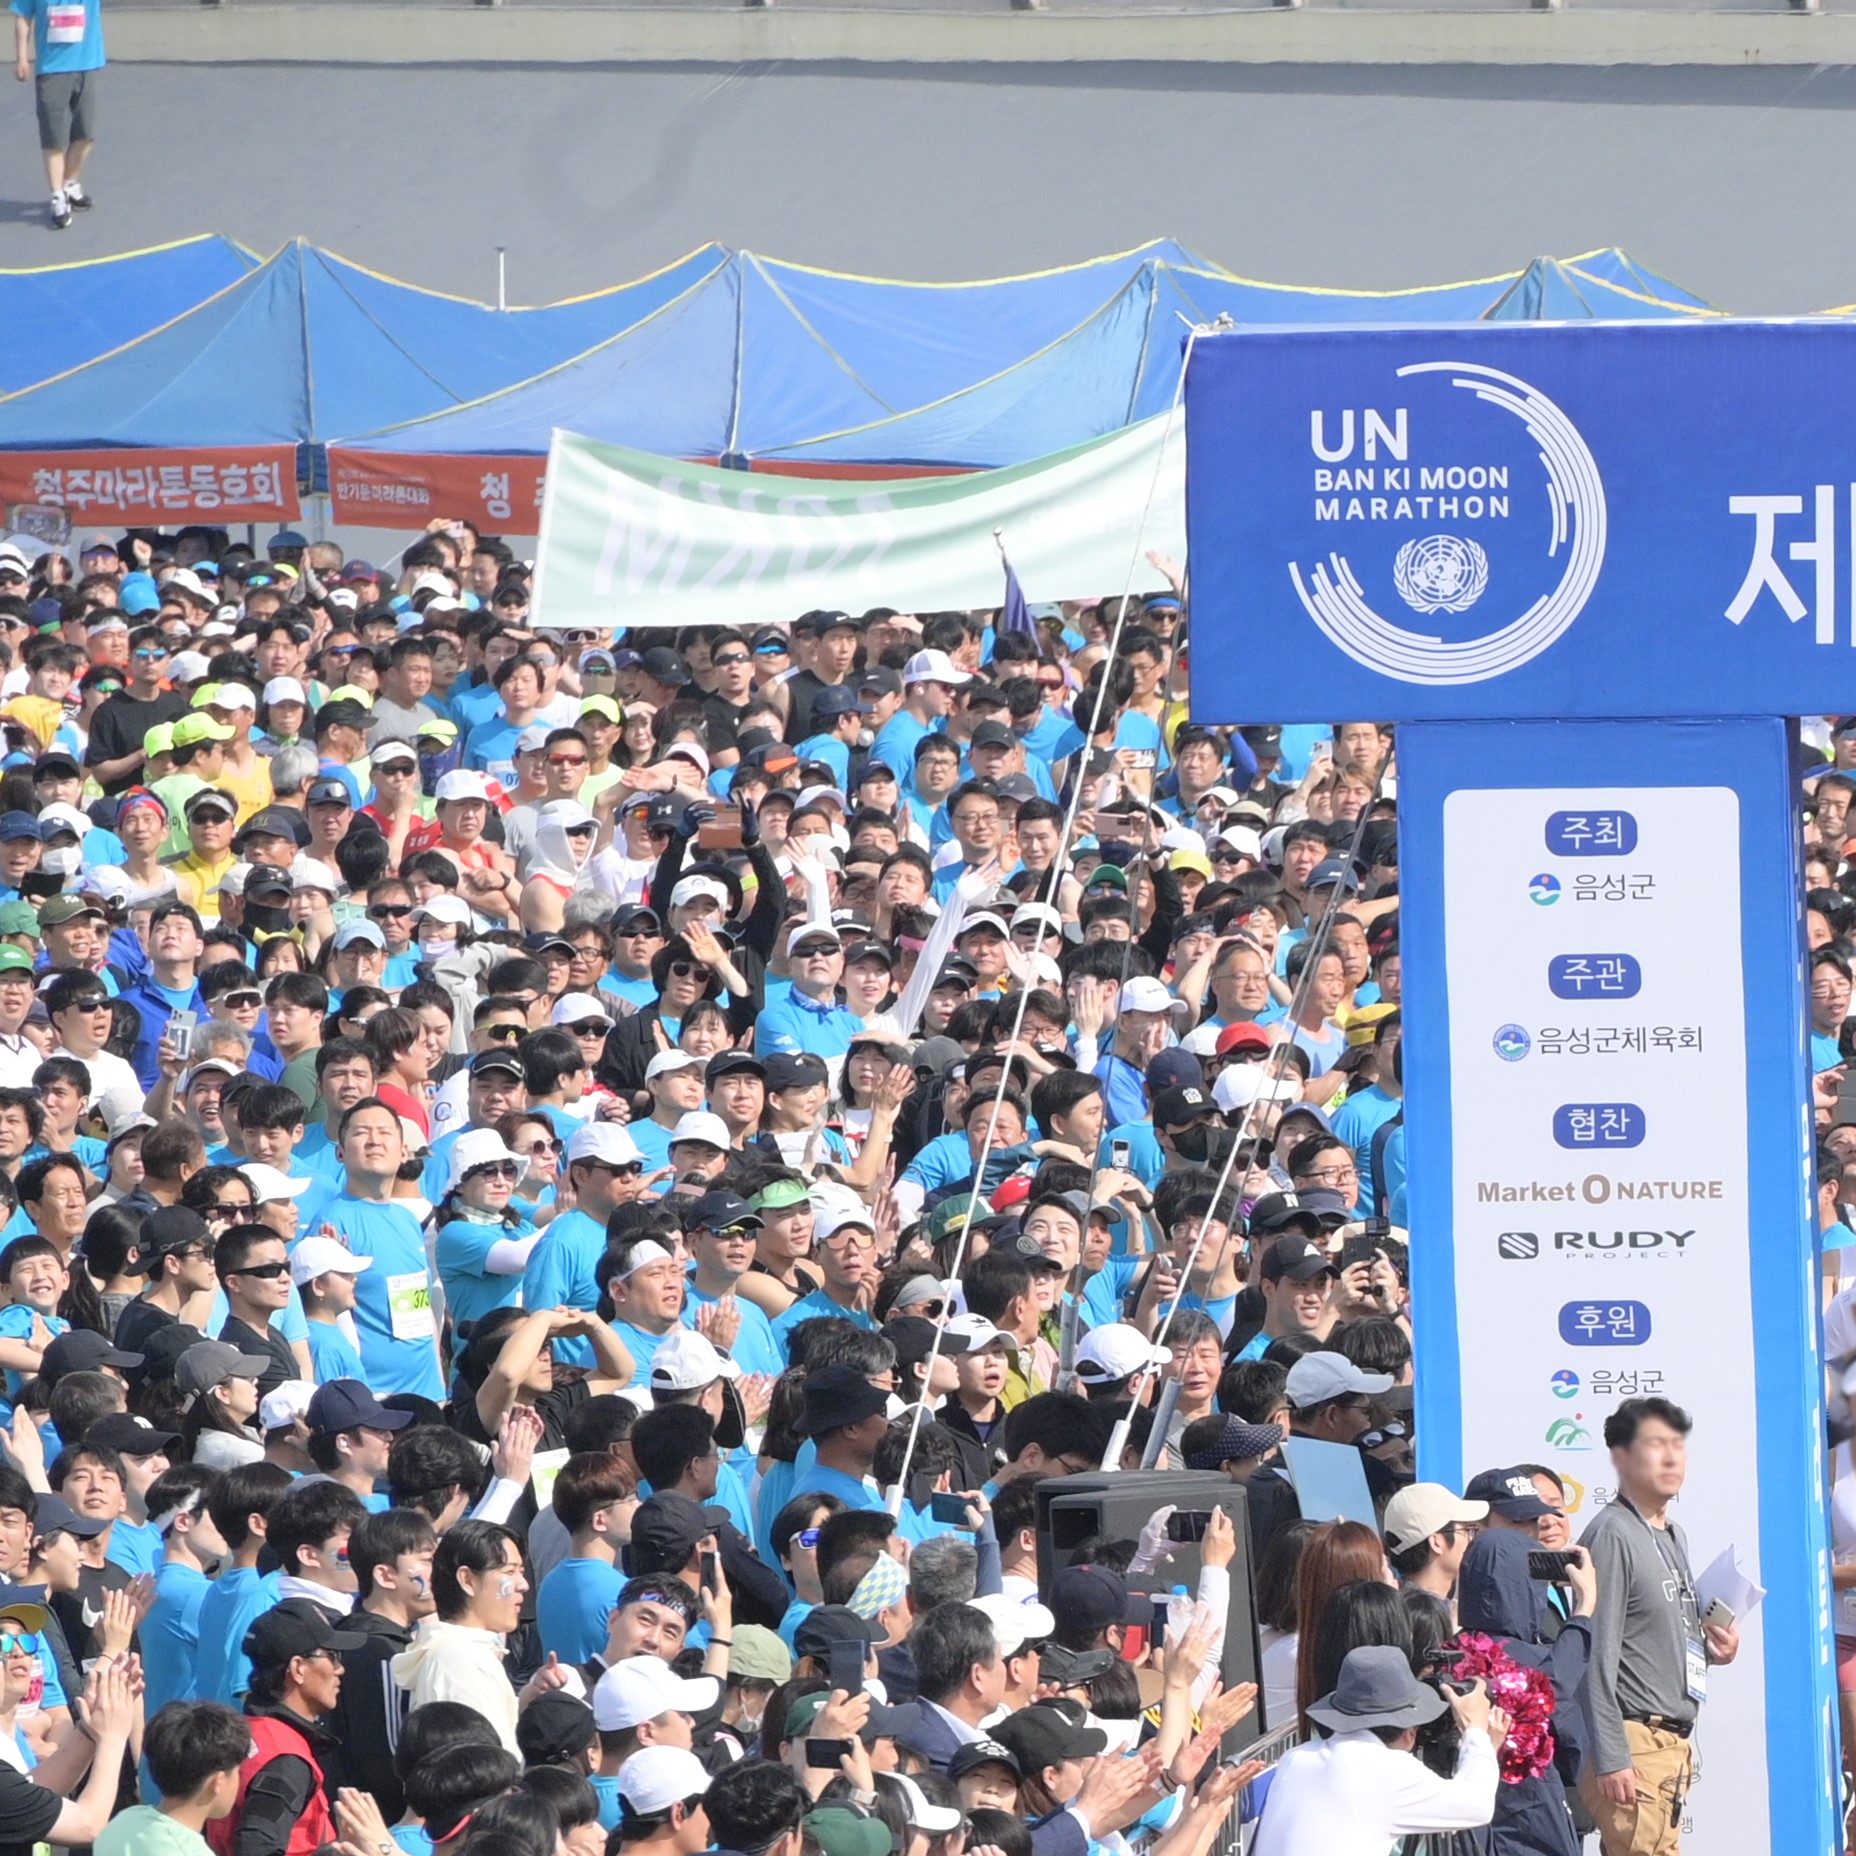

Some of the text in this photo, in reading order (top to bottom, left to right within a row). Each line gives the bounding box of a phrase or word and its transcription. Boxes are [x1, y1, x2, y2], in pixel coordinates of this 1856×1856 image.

[1310, 408, 1409, 463] UN
[32, 461, 286, 511] 청주마라톤동호회
[1315, 466, 1509, 492] BAN KI MOON
[1315, 495, 1510, 521] MARATHON
[1560, 815, 1623, 850] 주최
[1572, 873, 1656, 902] 음성군
[1562, 957, 1627, 991] 주관
[1537, 1025, 1703, 1055] 음성군체육회
[1567, 1108, 1632, 1141] 협찬
[1477, 1174, 1724, 1204] Market O NATURE
[1553, 1230, 1697, 1250] RUDY
[1566, 1250, 1686, 1260] PROJECT
[1574, 1305, 1637, 1338] 후원
[1590, 1369, 1665, 1395] 음성군
